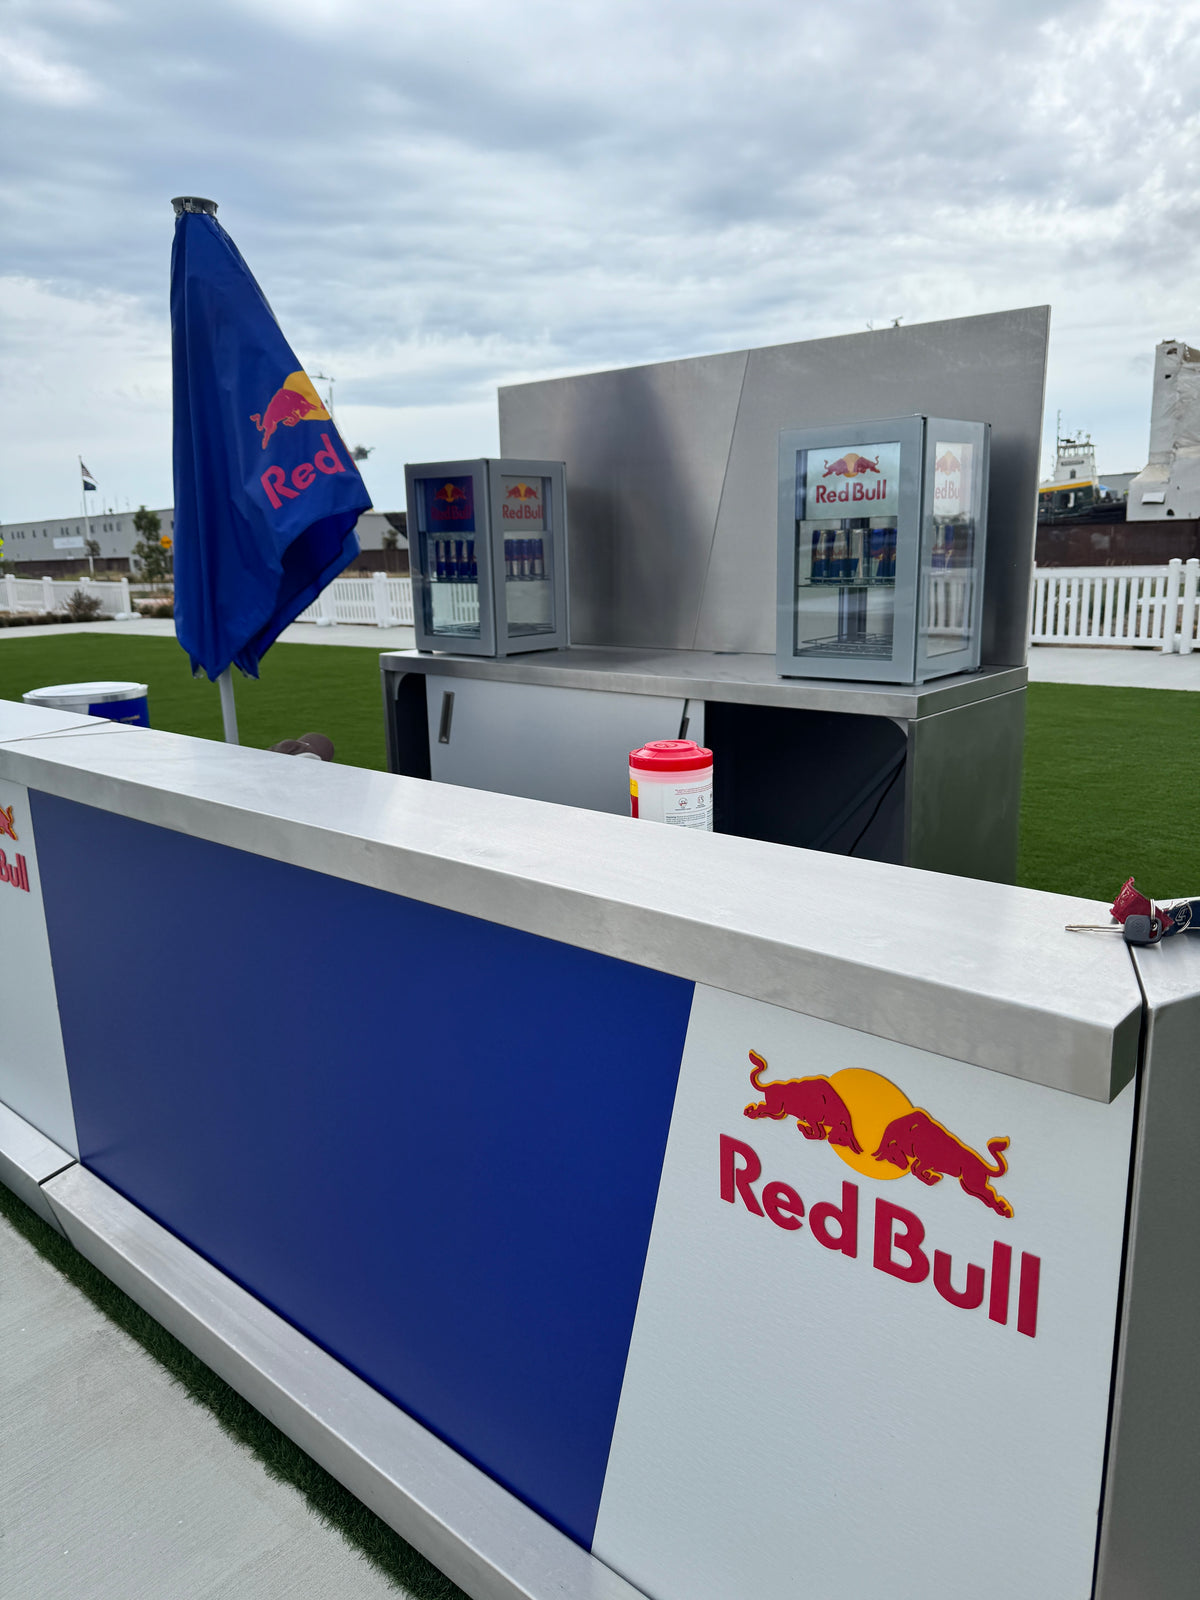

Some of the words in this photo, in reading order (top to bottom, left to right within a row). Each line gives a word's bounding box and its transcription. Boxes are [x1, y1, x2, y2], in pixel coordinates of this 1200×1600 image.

[260, 433, 346, 510] Red
[815, 482, 849, 504] Red
[852, 479, 887, 501] Bull
[935, 479, 948, 500] ed
[502, 503, 523, 519] Red
[524, 504, 544, 520] Bull
[719, 1133, 859, 1259] Red
[873, 1197, 1041, 1339] Bull
